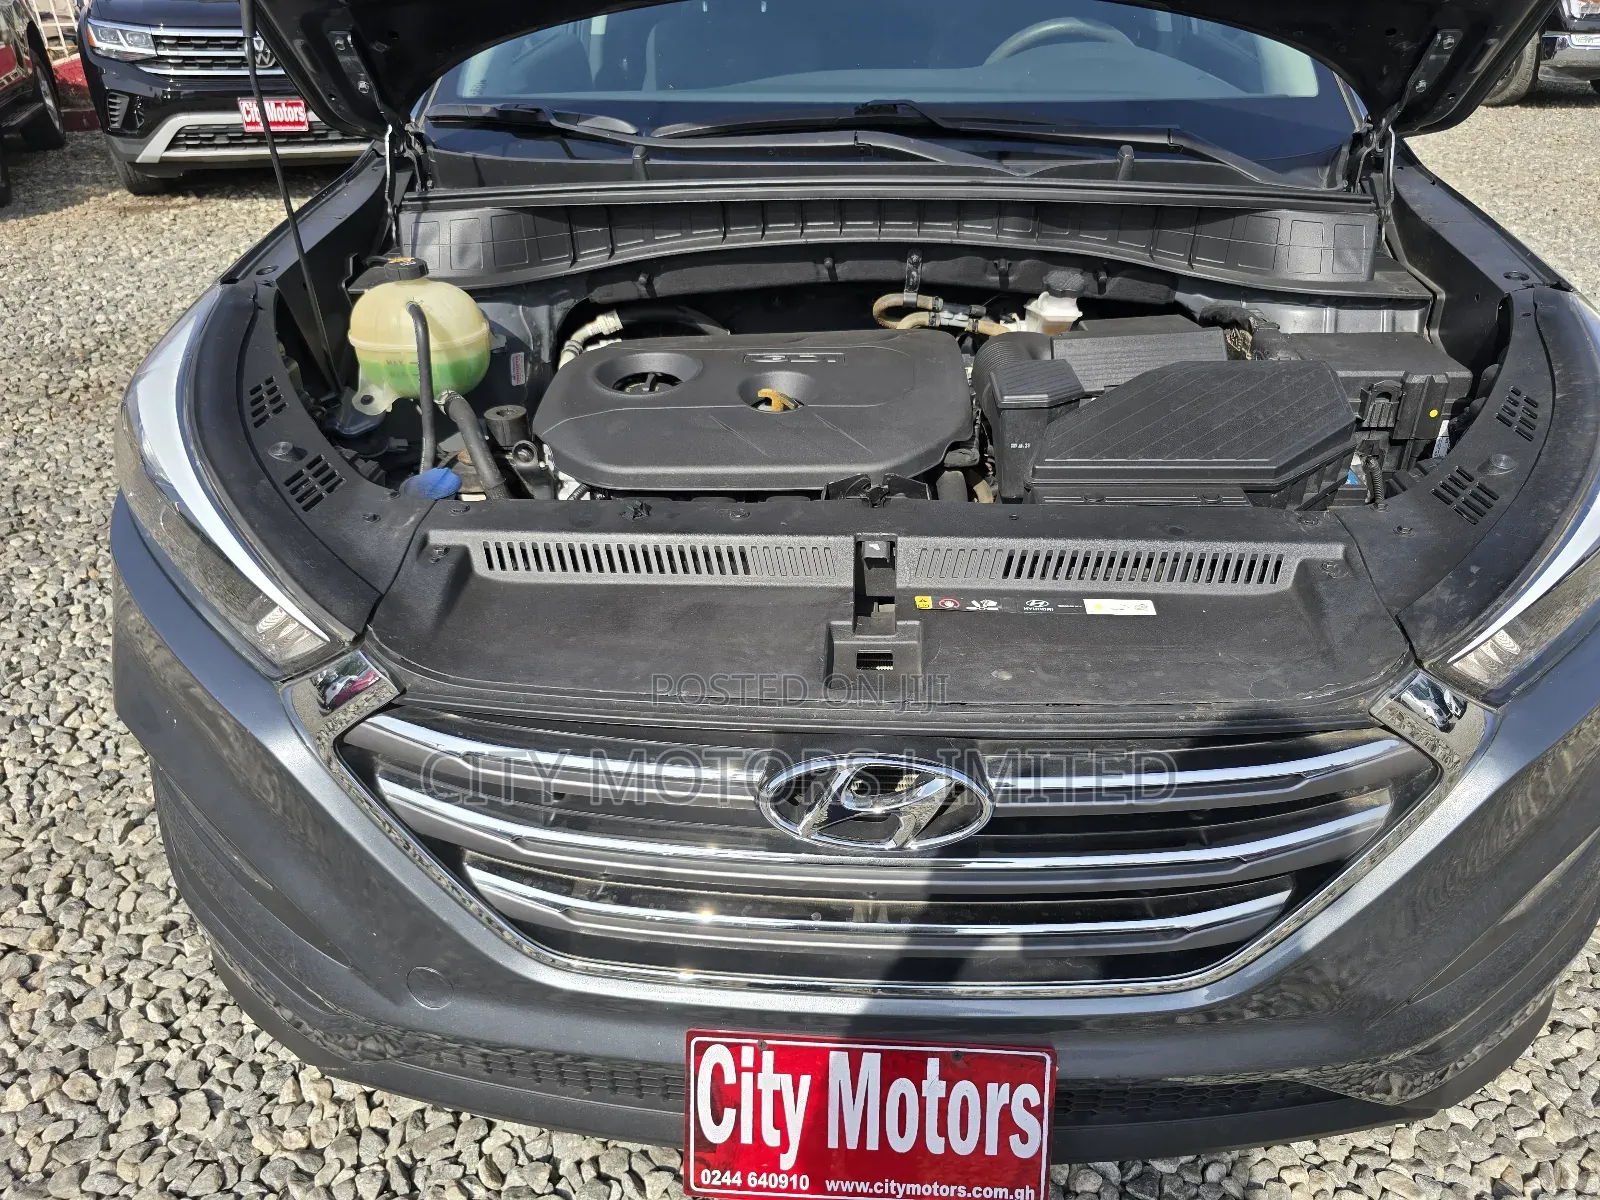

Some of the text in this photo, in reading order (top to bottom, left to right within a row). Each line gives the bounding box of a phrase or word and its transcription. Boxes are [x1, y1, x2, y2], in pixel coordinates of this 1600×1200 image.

[264, 102, 306, 122] Motors
[697, 1044, 1042, 1171] City Motors
[701, 1168, 1035, 1200] 0244 640910 www.citymotors.com.gh
